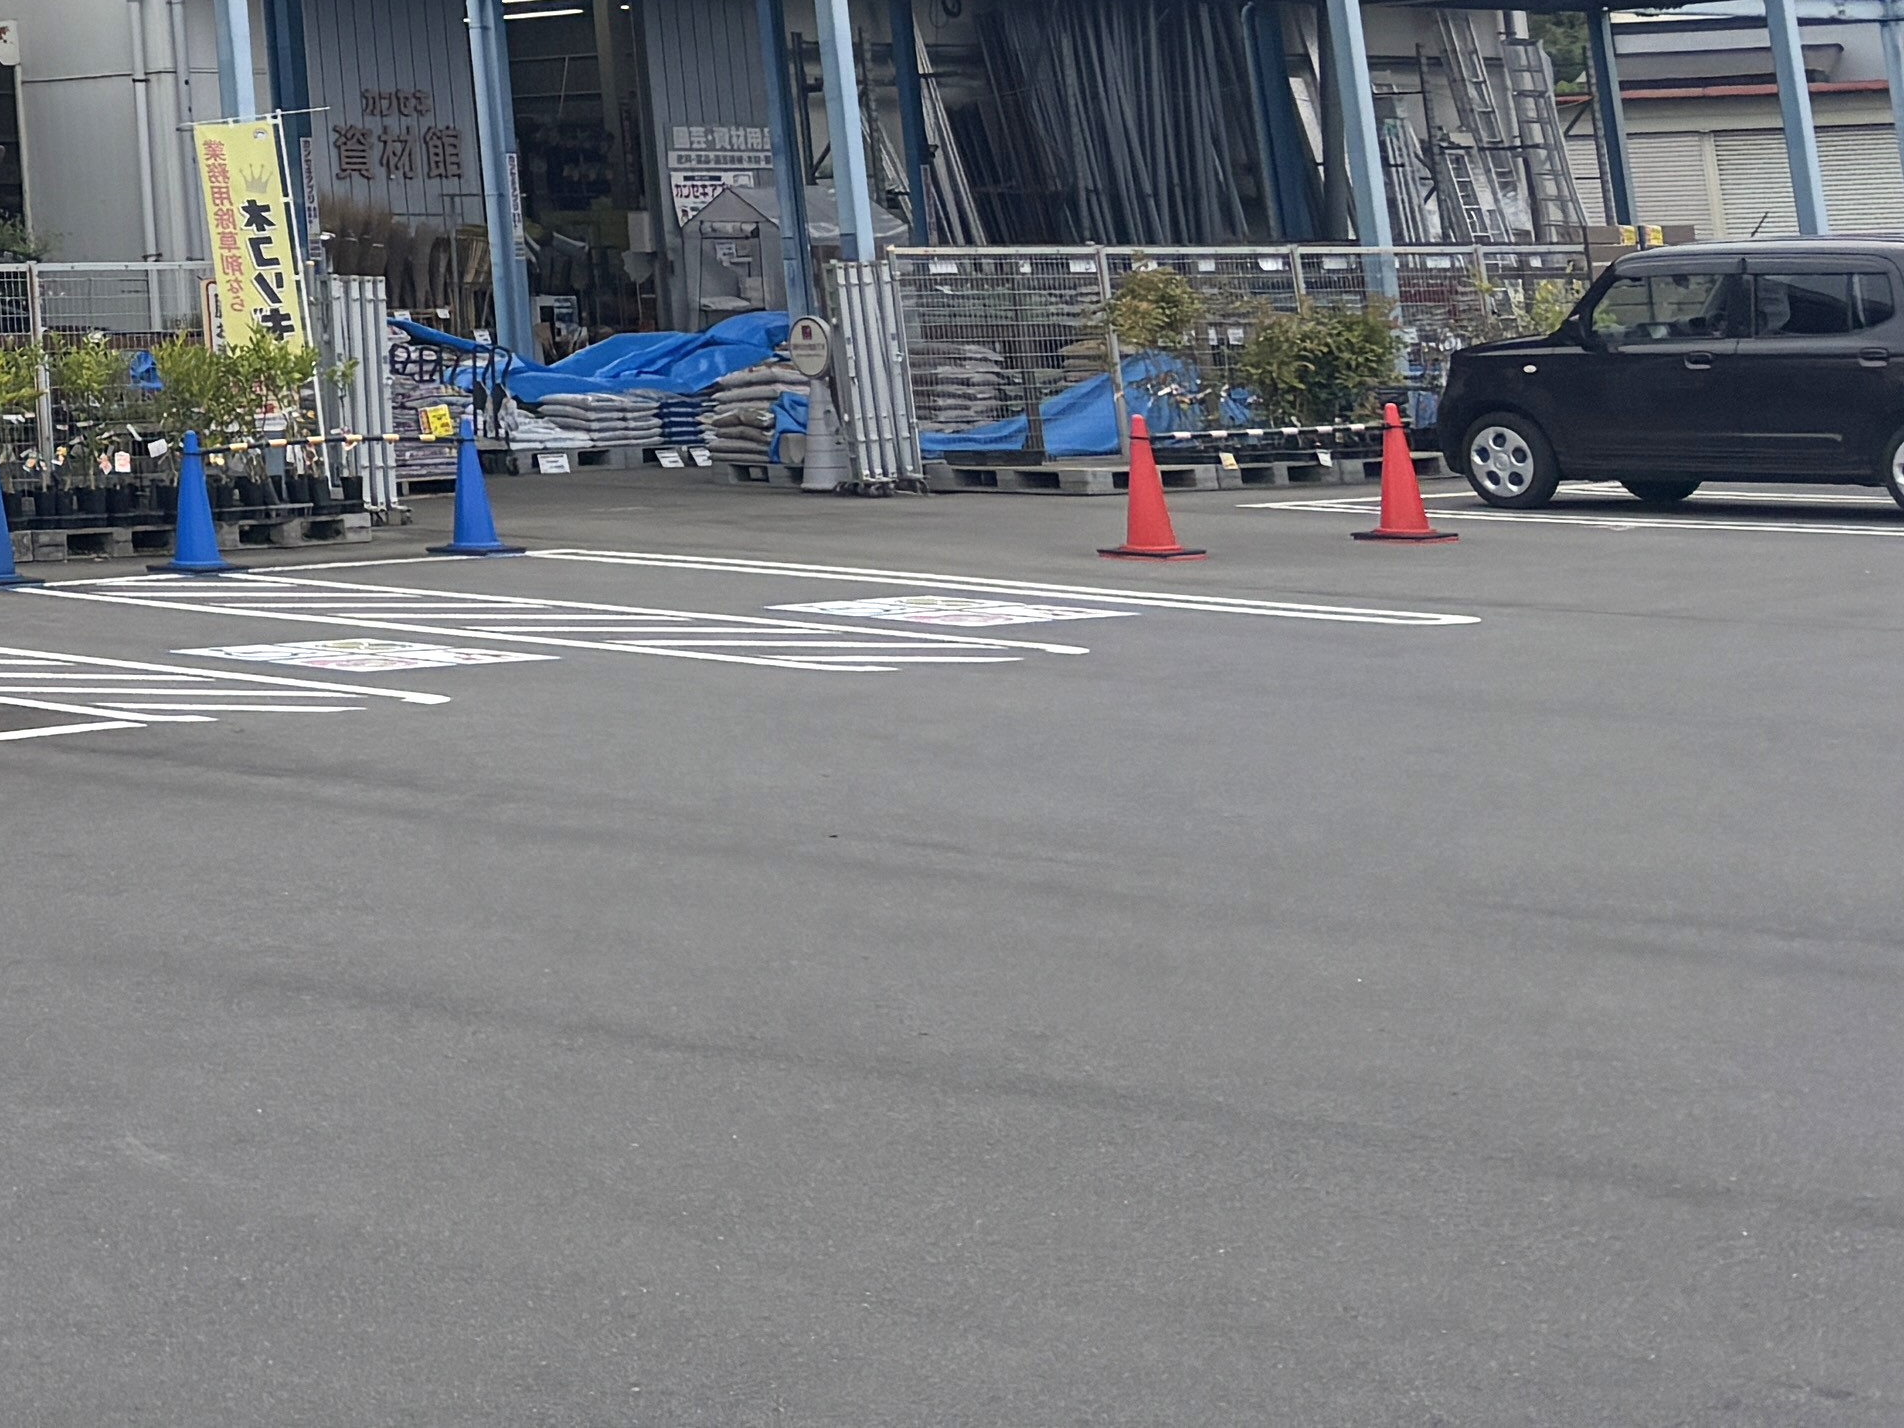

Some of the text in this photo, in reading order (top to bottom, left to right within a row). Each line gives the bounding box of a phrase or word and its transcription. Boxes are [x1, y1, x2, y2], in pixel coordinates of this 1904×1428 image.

[333, 124, 464, 180] 資材館
[674, 183, 730, 199] カンセキア
